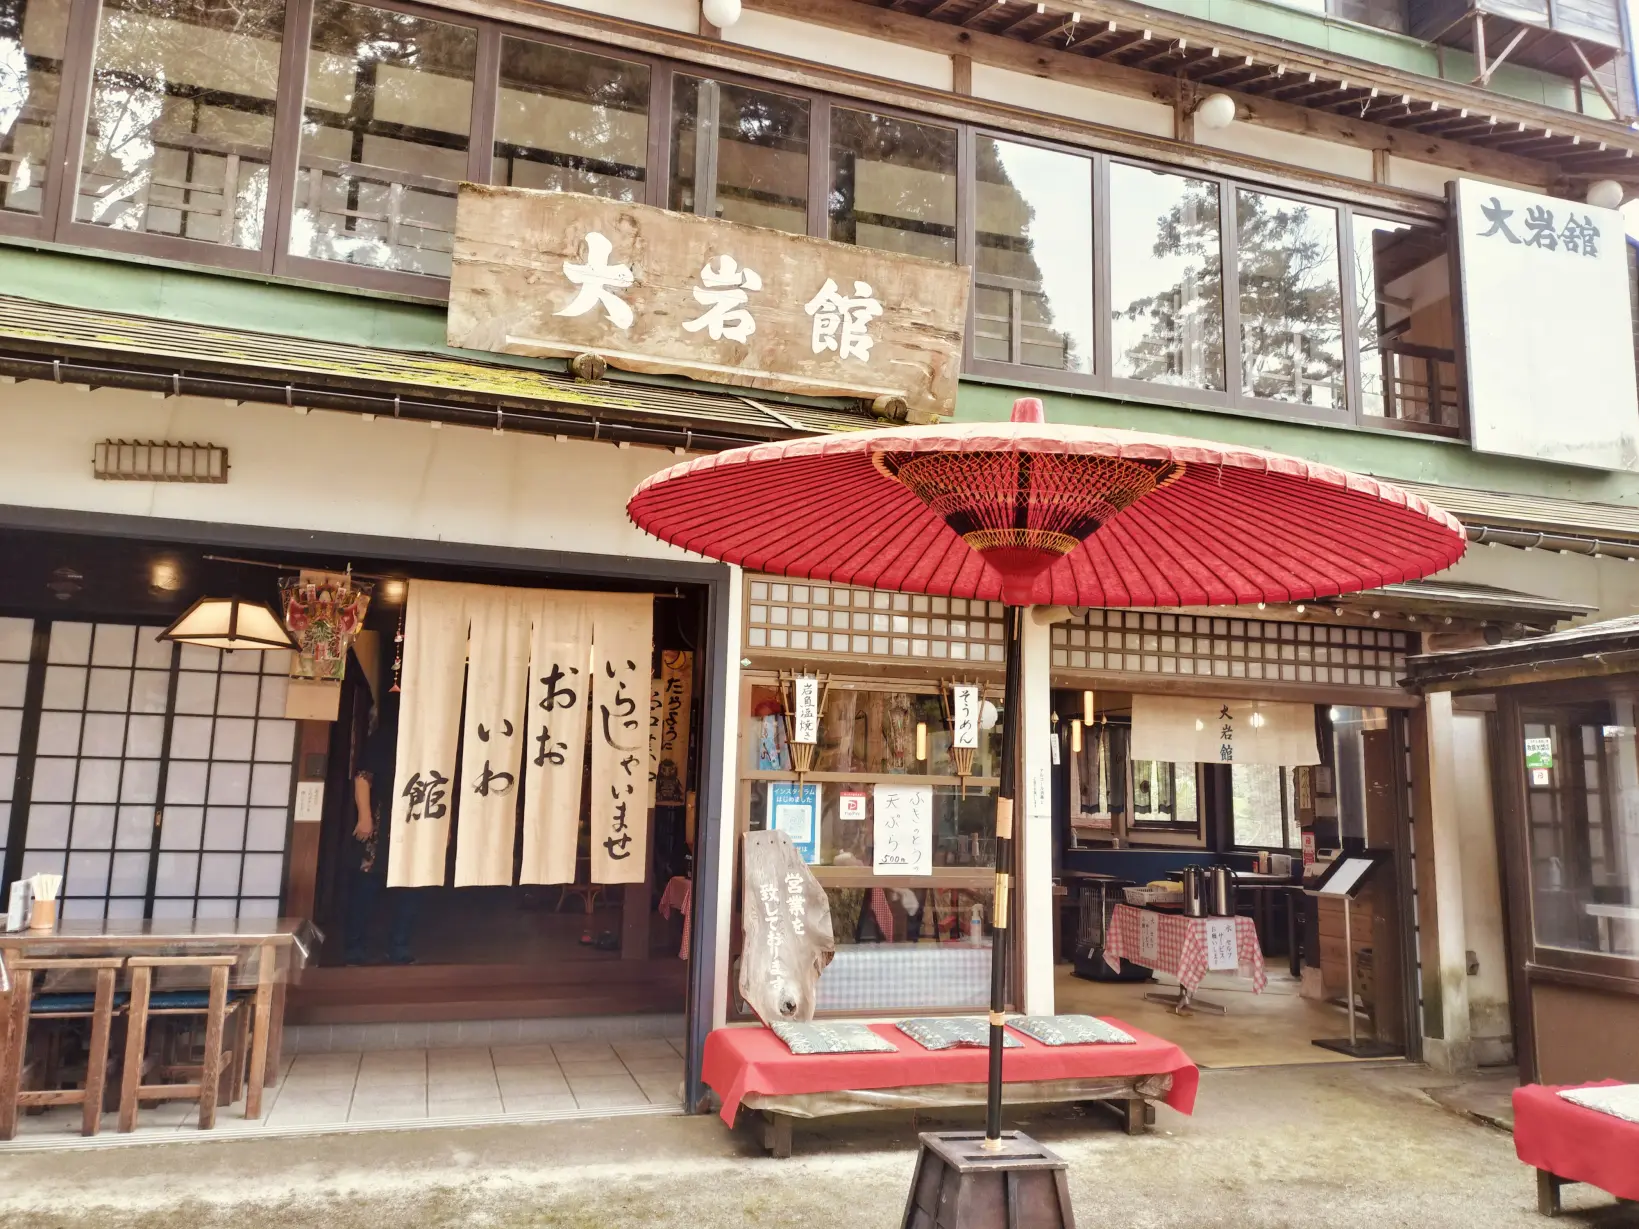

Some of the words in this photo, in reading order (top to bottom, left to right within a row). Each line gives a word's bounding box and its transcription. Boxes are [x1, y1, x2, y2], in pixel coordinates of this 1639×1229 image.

[1476, 196, 1601, 258] 大岩館
[552, 231, 884, 362] 大岩館
[533, 663, 579, 767] おお
[799, 683, 816, 741] 岩魚塩焼き
[957, 690, 974, 745] そうめん
[1218, 703, 1234, 762] 大岩館
[472, 719, 514, 796] いわ
[600, 659, 642, 860] いらっしゃいませ
[402, 769, 450, 824] 館
[884, 793, 900, 853] 天ぷら
[785, 872, 805, 935] 営業を
[759, 885, 786, 990] 致しております
